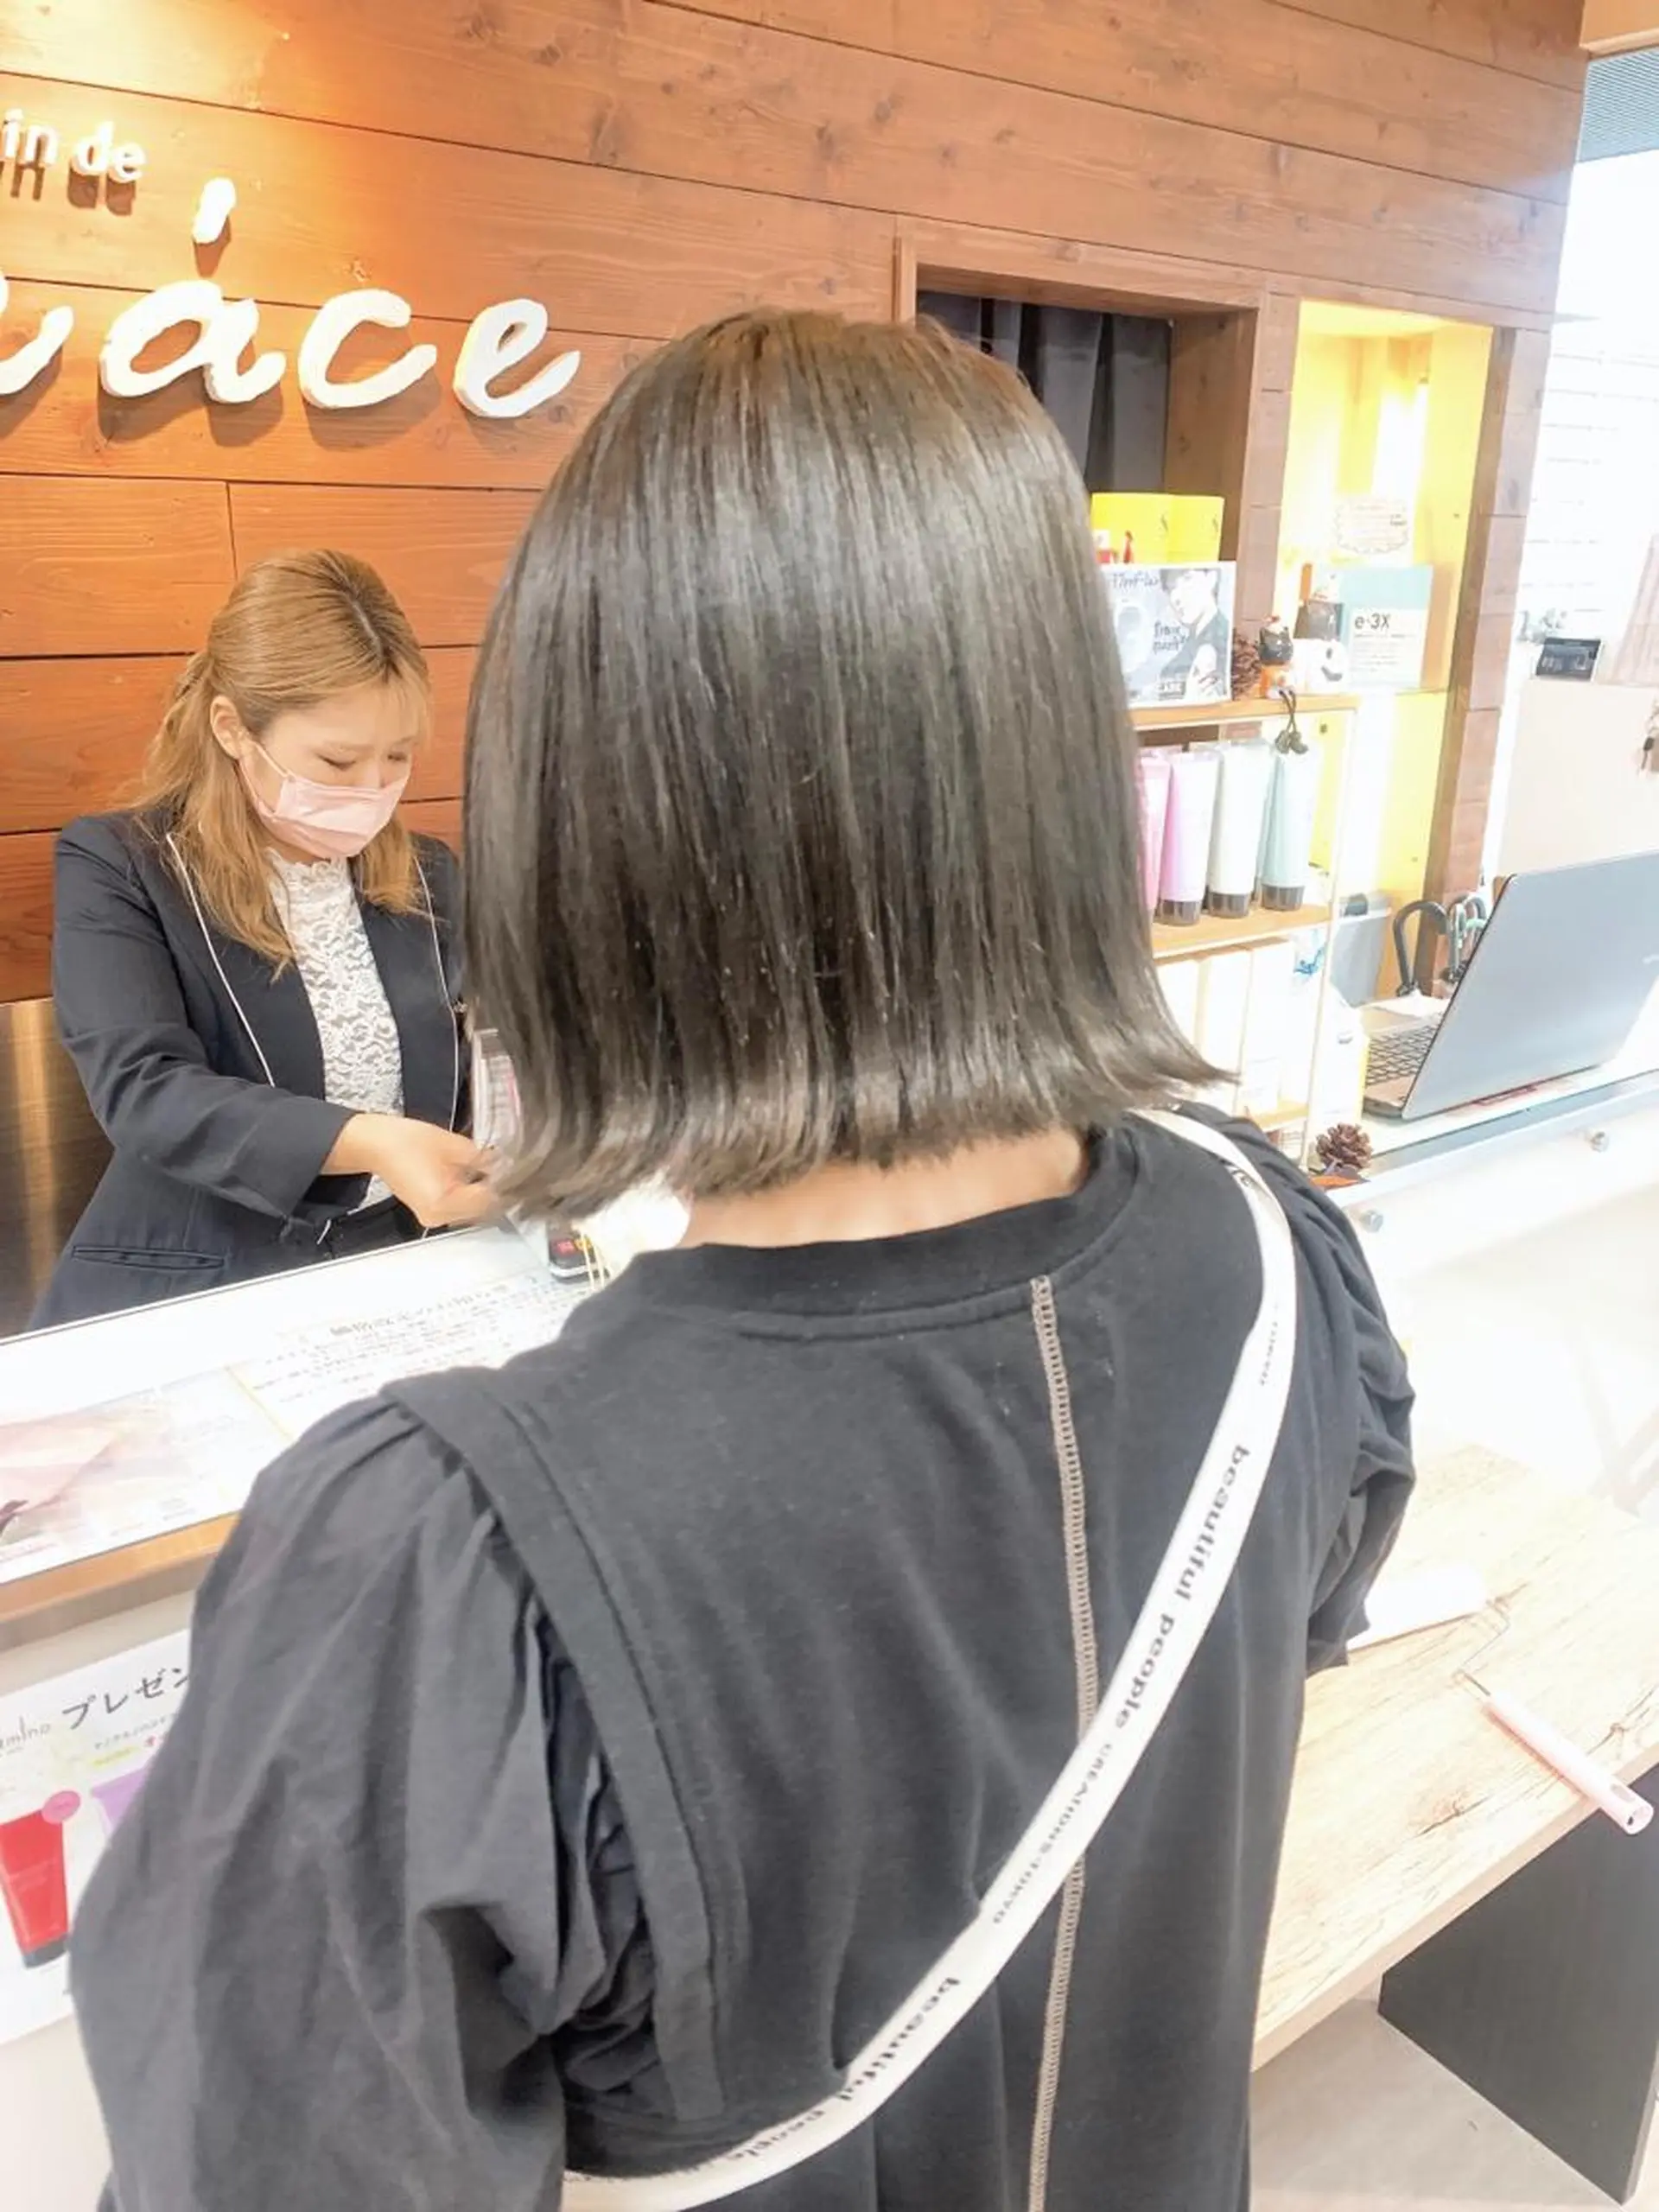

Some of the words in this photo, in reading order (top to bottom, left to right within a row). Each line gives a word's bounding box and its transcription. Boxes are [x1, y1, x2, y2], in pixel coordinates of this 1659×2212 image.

[75, 120, 147, 183] de
[1173, 1444, 1251, 1601] beautiful
[1115, 1612, 1176, 1729] people
[836, 1976, 960, 2101] beautiful
[728, 2109, 824, 2160] people
